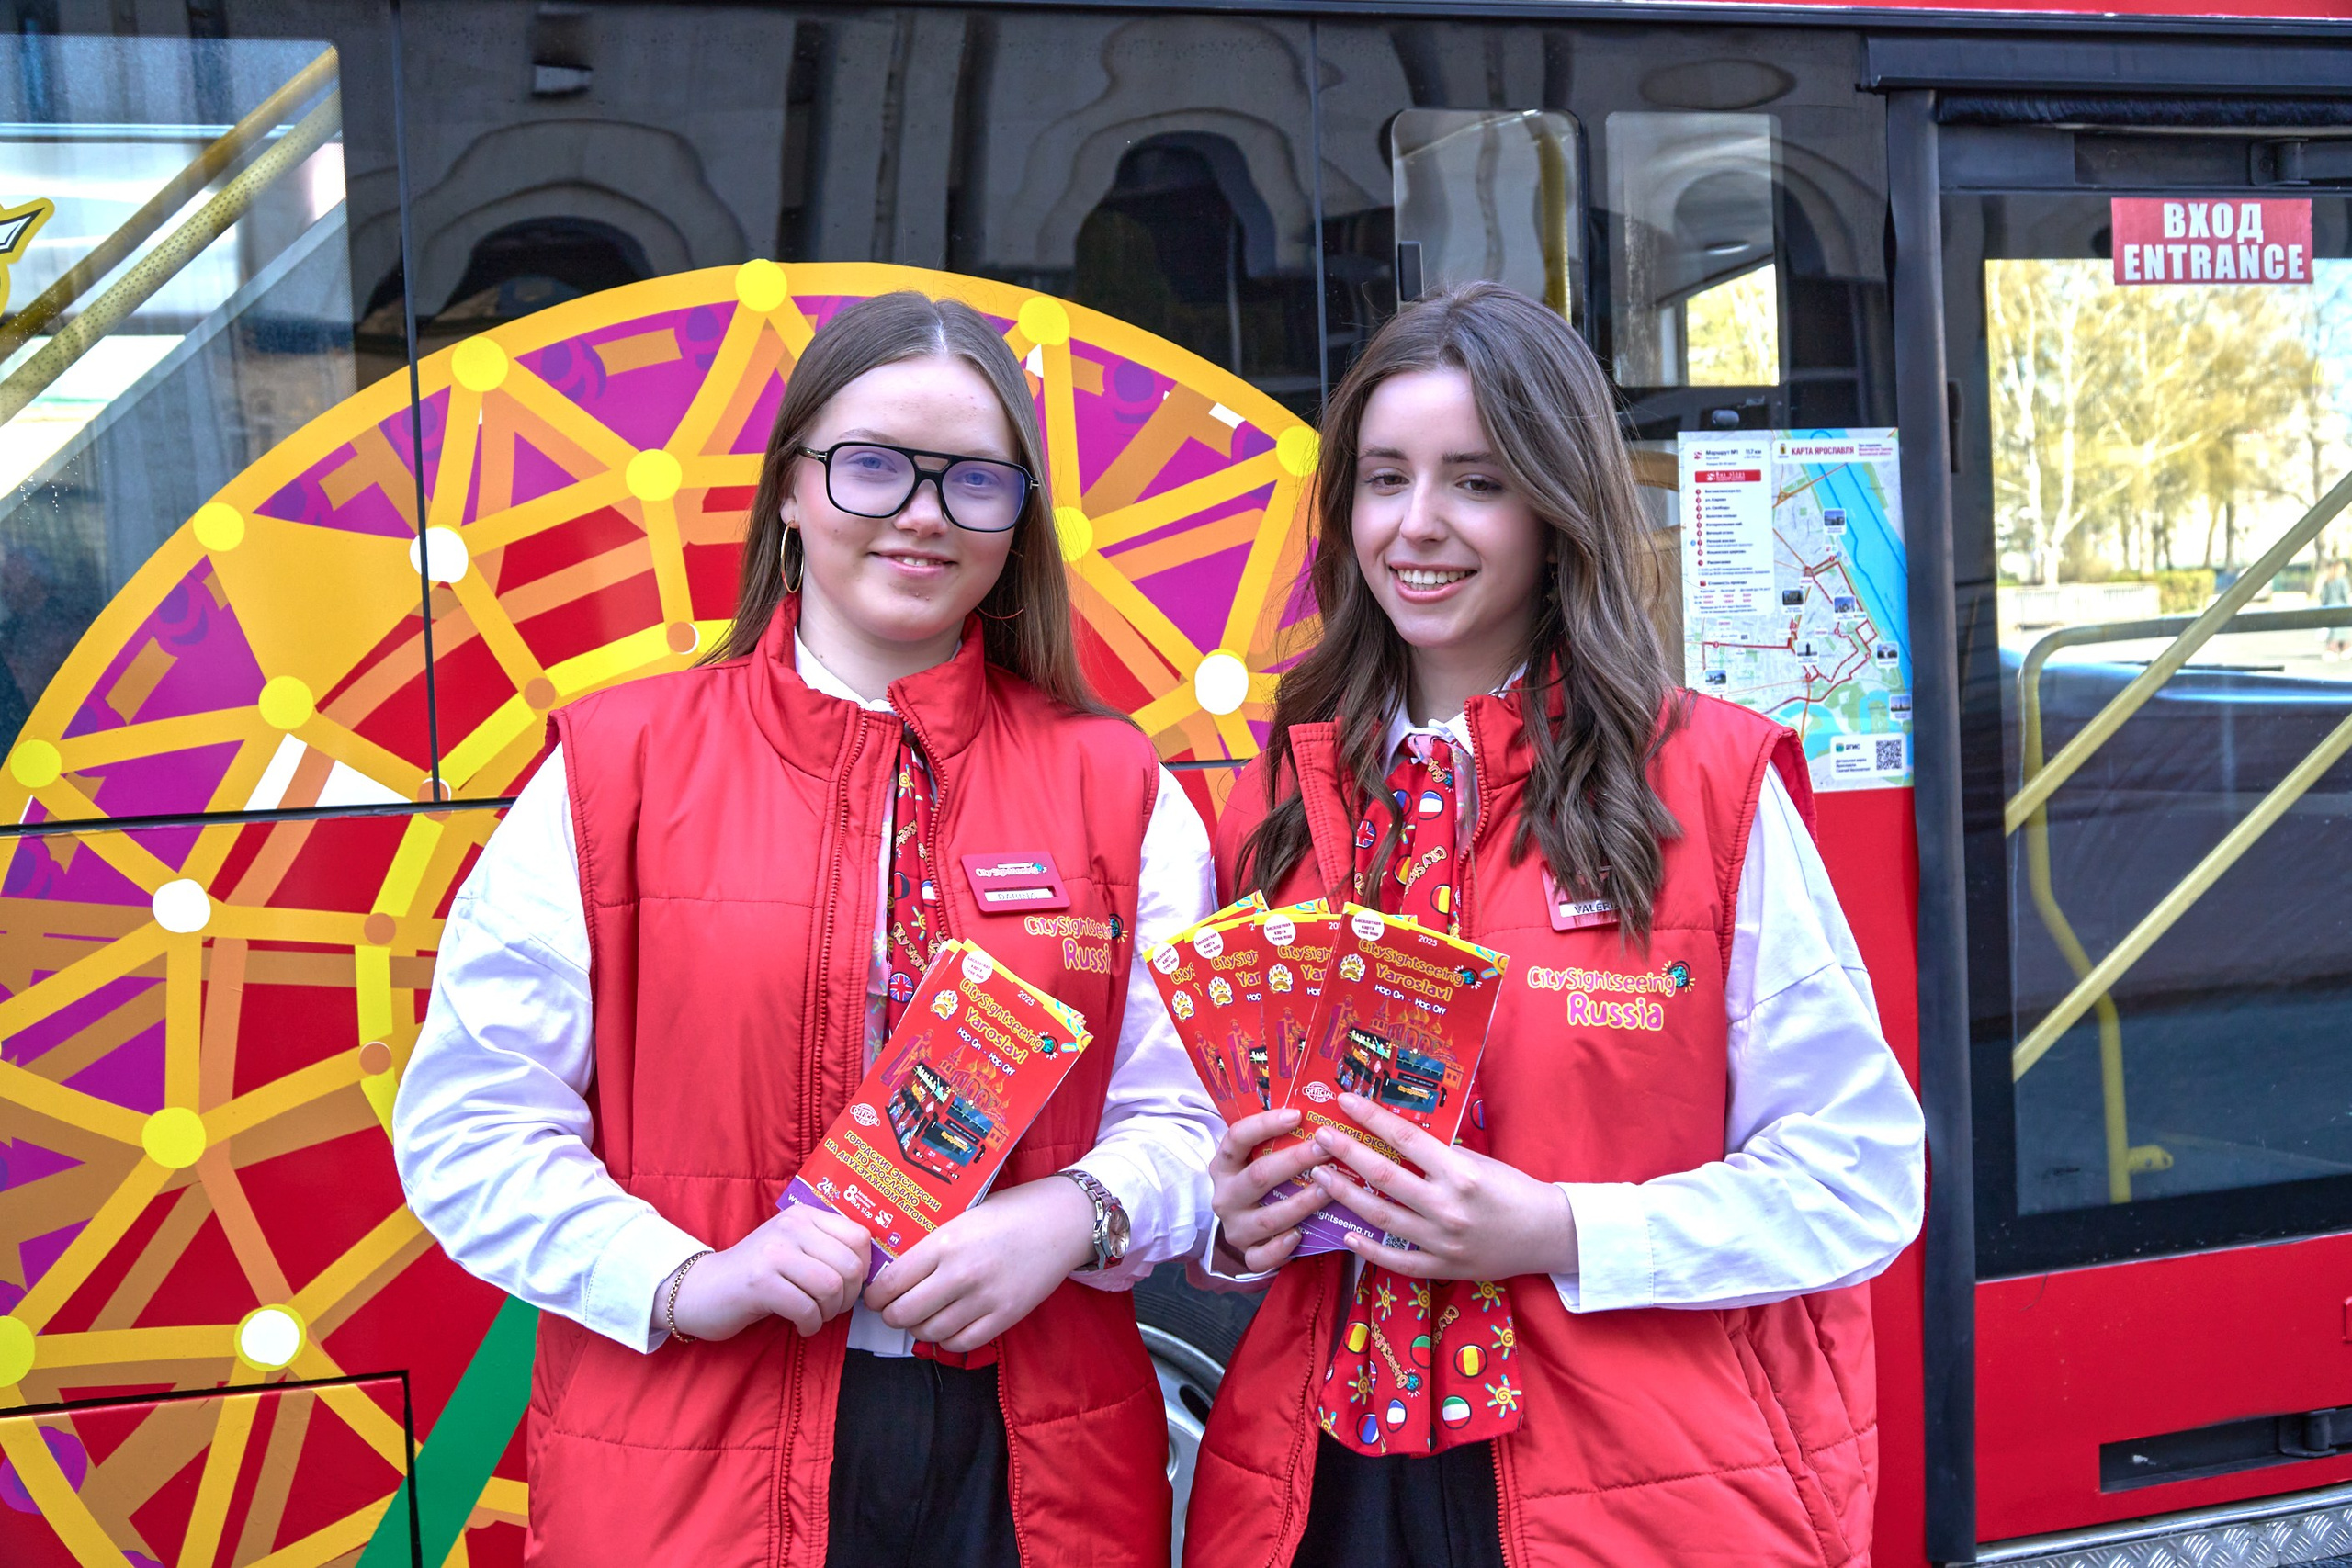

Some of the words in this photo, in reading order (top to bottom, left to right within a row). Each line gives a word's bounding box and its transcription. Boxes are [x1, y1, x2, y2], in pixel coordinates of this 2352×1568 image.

[2163, 202, 2264, 244] ВХОД
[2123, 243, 2304, 281] ENTRANCE
[1792, 447, 1814, 456] КАРТА
[1815, 446, 1855, 455] ЯРОСЛАВЛЯ
[1023, 916, 1112, 941] CitySightsee
[1418, 934, 1438, 947] 2025
[1061, 937, 1112, 976] Russi
[1358, 939, 1465, 987] CitySightseeing
[1017, 990, 1035, 1007] 2025
[1374, 984, 1391, 997] Hop
[1392, 989, 1405, 1001] On
[1414, 998, 1431, 1011] Hop
[1431, 1003, 1447, 1016] Off
[1375, 963, 1453, 1002] Yaroslavl
[1527, 965, 1678, 998] CitySightseeing
[959, 978, 1046, 1053] CitySightseeing
[1566, 990, 1665, 1032] Russia
[956, 1026, 972, 1043] Hop
[971, 1038, 982, 1051] On
[988, 1052, 1002, 1067] Hop
[1001, 1063, 1016, 1077] Off
[965, 1006, 1029, 1064] Yaroslavl
[824, 1139, 838, 1155] НА
[836, 1150, 899, 1203] ДВУХЭТАЖНОМ
[844, 1130, 892, 1172] ГОРОДСКИЕ
[890, 1168, 942, 1212] ЭКСКУРСИИ
[854, 1151, 868, 1166] ПО
[867, 1162, 920, 1207] ЯРОСЛАВЛЮ
[843, 1184, 859, 1201] 8
[850, 1198, 861, 1210] Bus
[861, 1207, 873, 1219] stop
